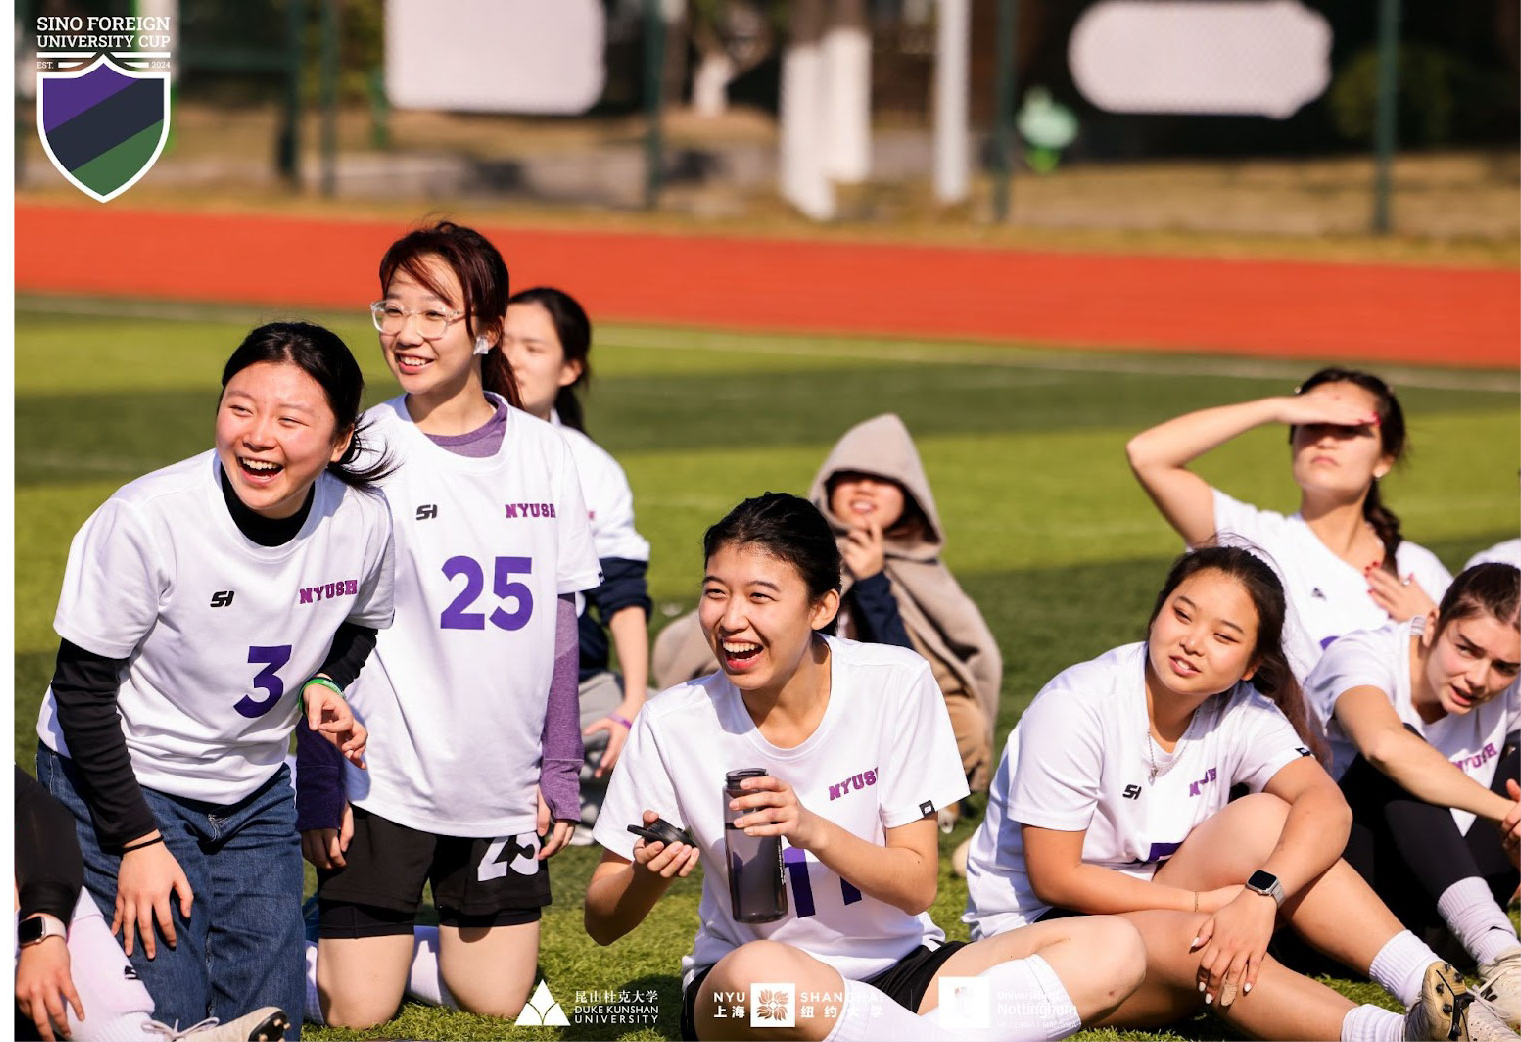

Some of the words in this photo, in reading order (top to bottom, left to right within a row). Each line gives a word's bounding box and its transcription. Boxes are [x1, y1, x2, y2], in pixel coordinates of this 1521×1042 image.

[299, 579, 359, 604] NYUSH
[440, 555, 534, 632] 25
[233, 644, 293, 719] 3
[828, 767, 879, 801] NYUS
